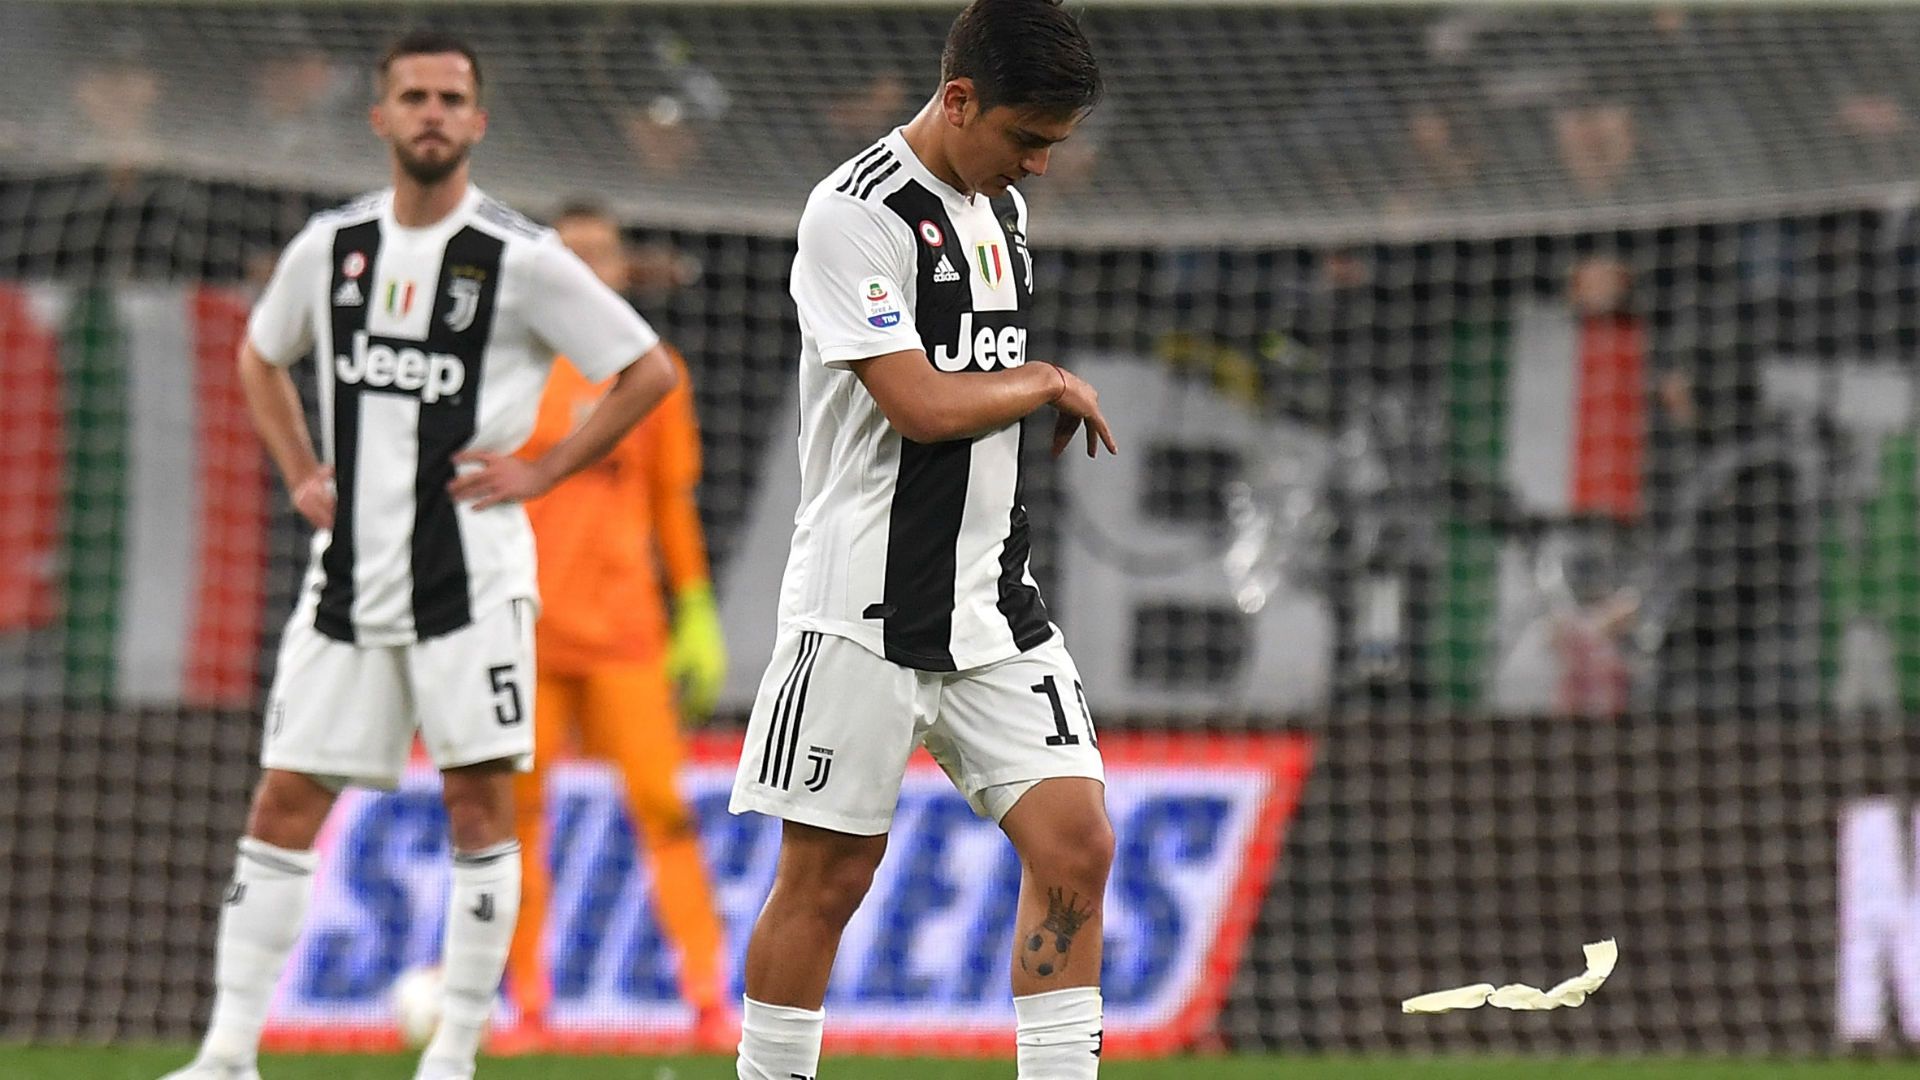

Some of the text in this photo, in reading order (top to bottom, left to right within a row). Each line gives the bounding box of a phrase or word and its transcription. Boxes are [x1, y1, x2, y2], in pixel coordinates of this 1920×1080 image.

[881, 314, 898, 324] TIM
[335, 330, 466, 404] Jeep
[487, 663, 521, 726] 5
